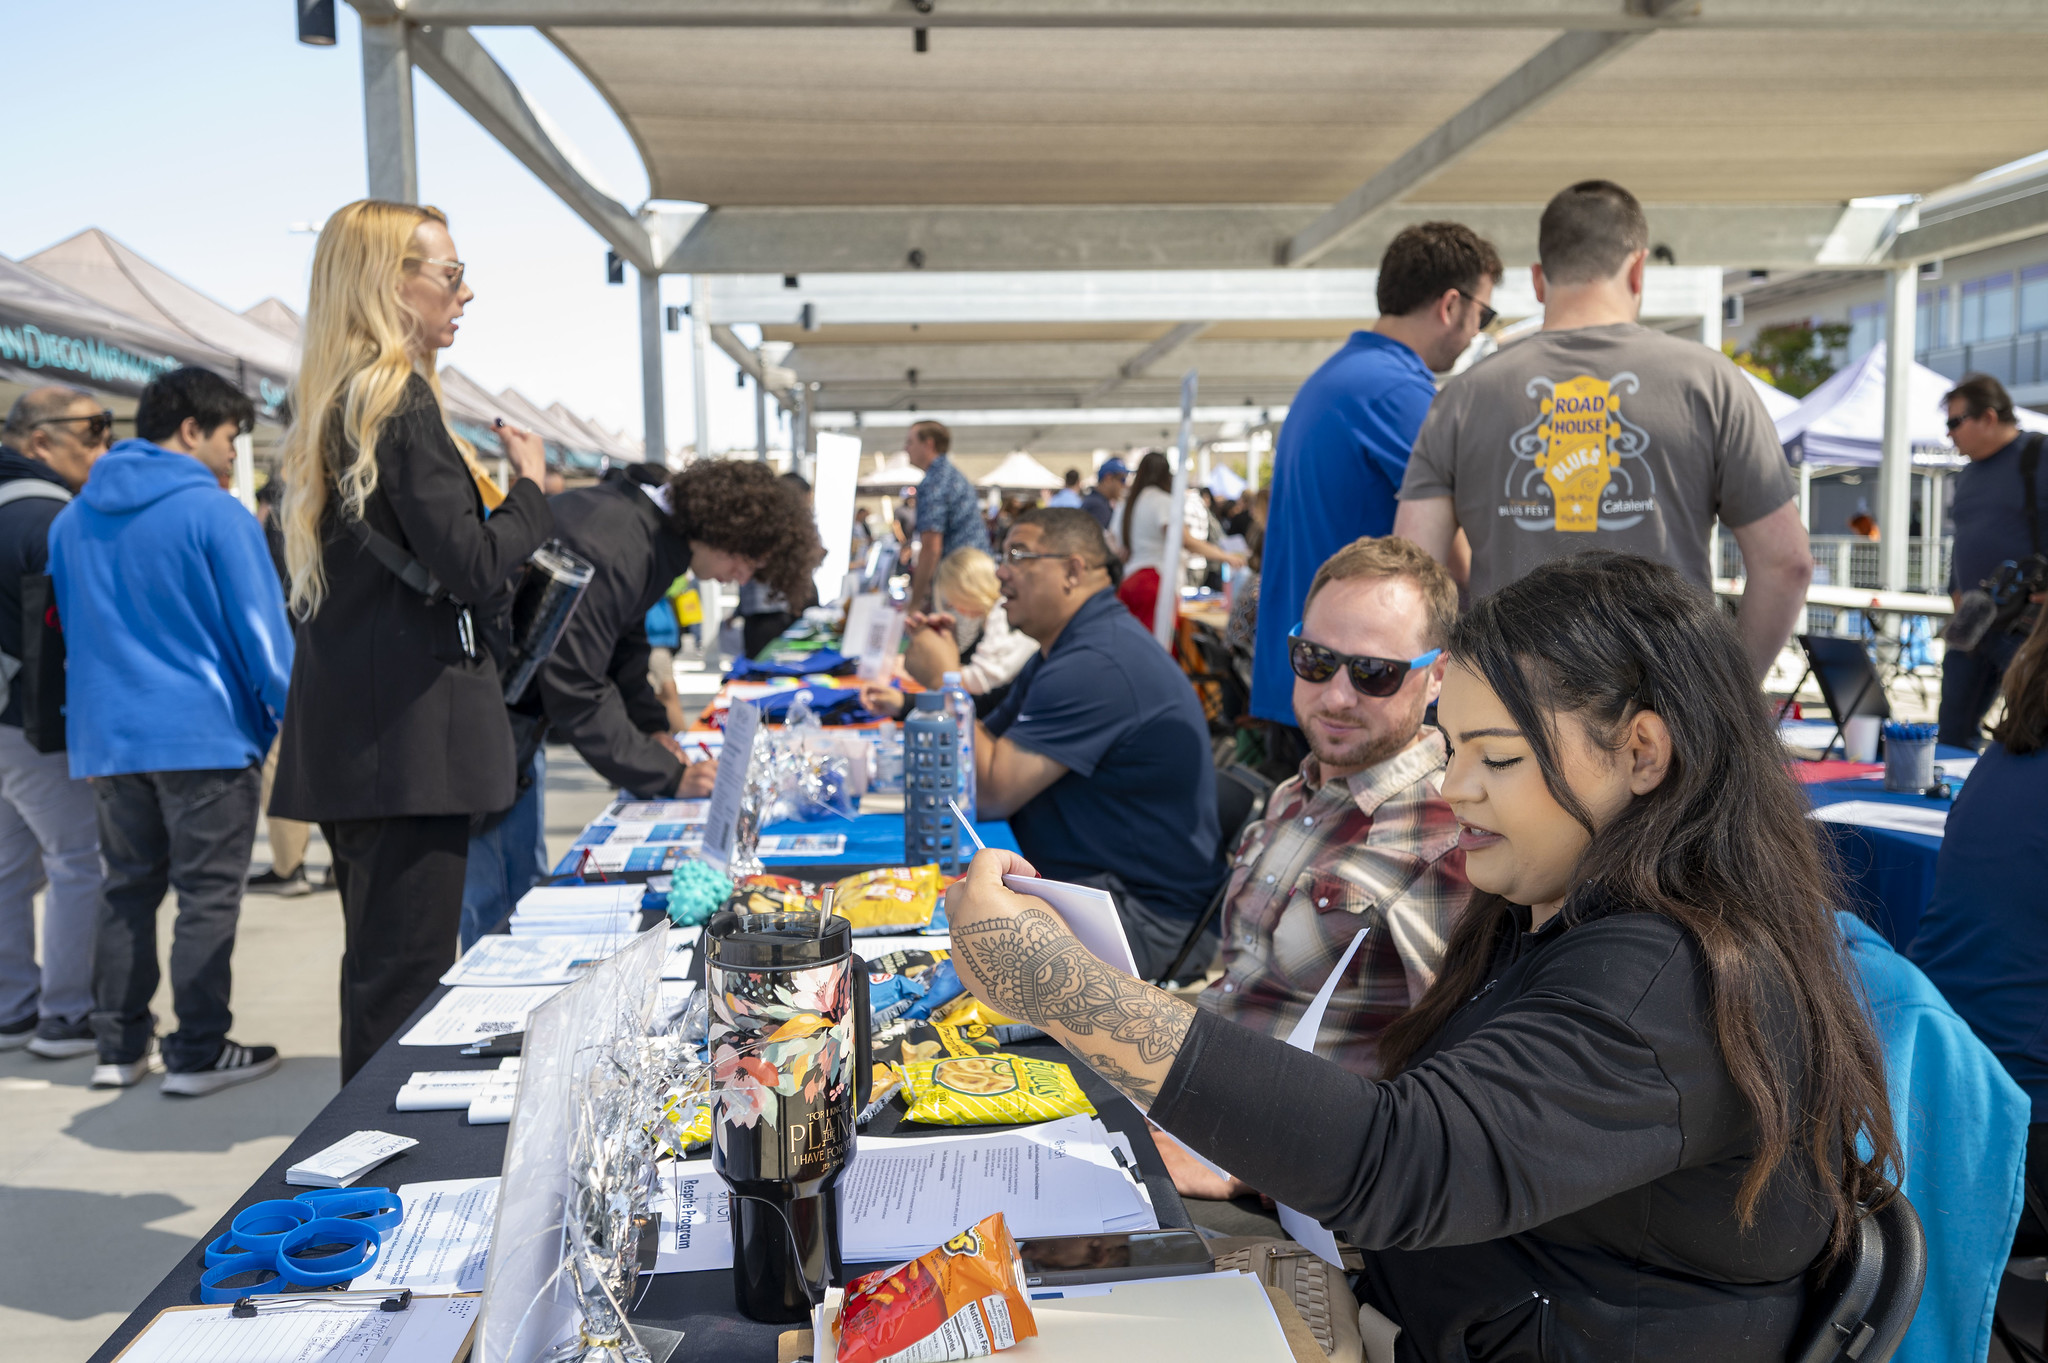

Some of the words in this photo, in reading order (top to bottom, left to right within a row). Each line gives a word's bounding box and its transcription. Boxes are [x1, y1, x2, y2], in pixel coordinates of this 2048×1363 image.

[1555, 397, 1605, 414] ROAD
[1554, 420, 1604, 435] HOUSE
[1551, 448, 1602, 482] BLUES
[1525, 505, 1550, 516] FEST
[1602, 498, 1656, 514] Catalent
[794, 1155, 797, 1166] I
[800, 1149, 826, 1166] HAVE
[826, 1142, 844, 1160] FOR
[682, 1179, 699, 1208] Respite
[676, 1209, 697, 1249] Program
[968, 1303, 984, 1339] Nutrition
[943, 1322, 956, 1353] Calories
